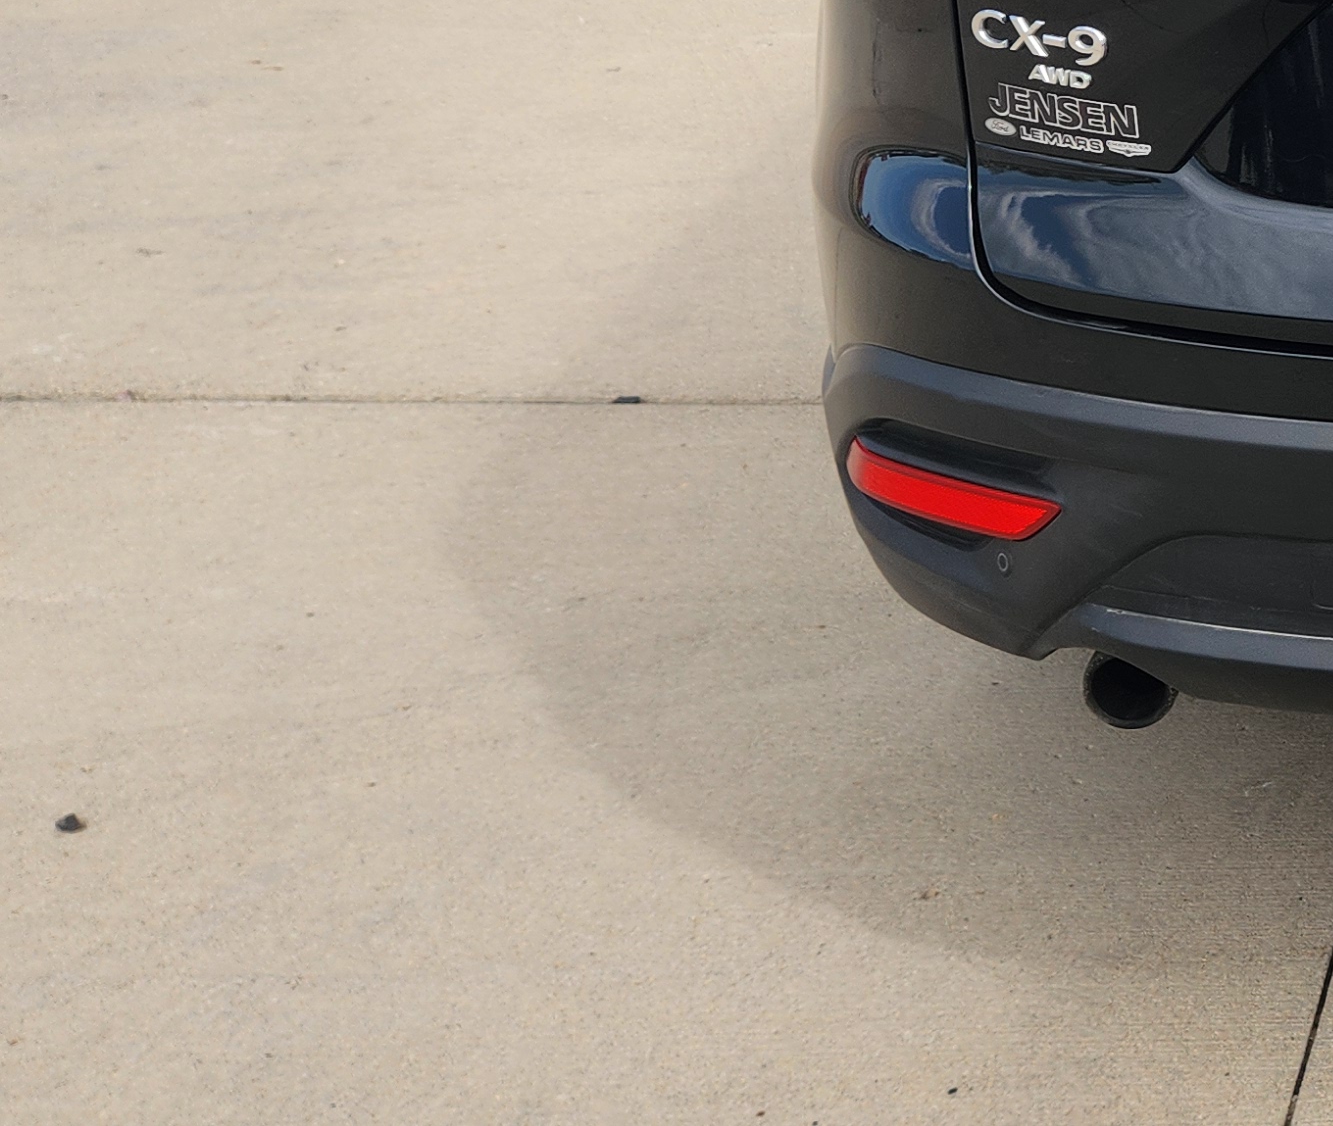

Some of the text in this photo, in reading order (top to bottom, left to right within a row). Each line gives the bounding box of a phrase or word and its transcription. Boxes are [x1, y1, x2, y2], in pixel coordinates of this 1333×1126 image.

[971, 9, 1108, 66] CX-9
[1028, 64, 1092, 89] AWD
[988, 82, 1140, 139] JENSEN
[1020, 126, 1104, 153] LEMARS
